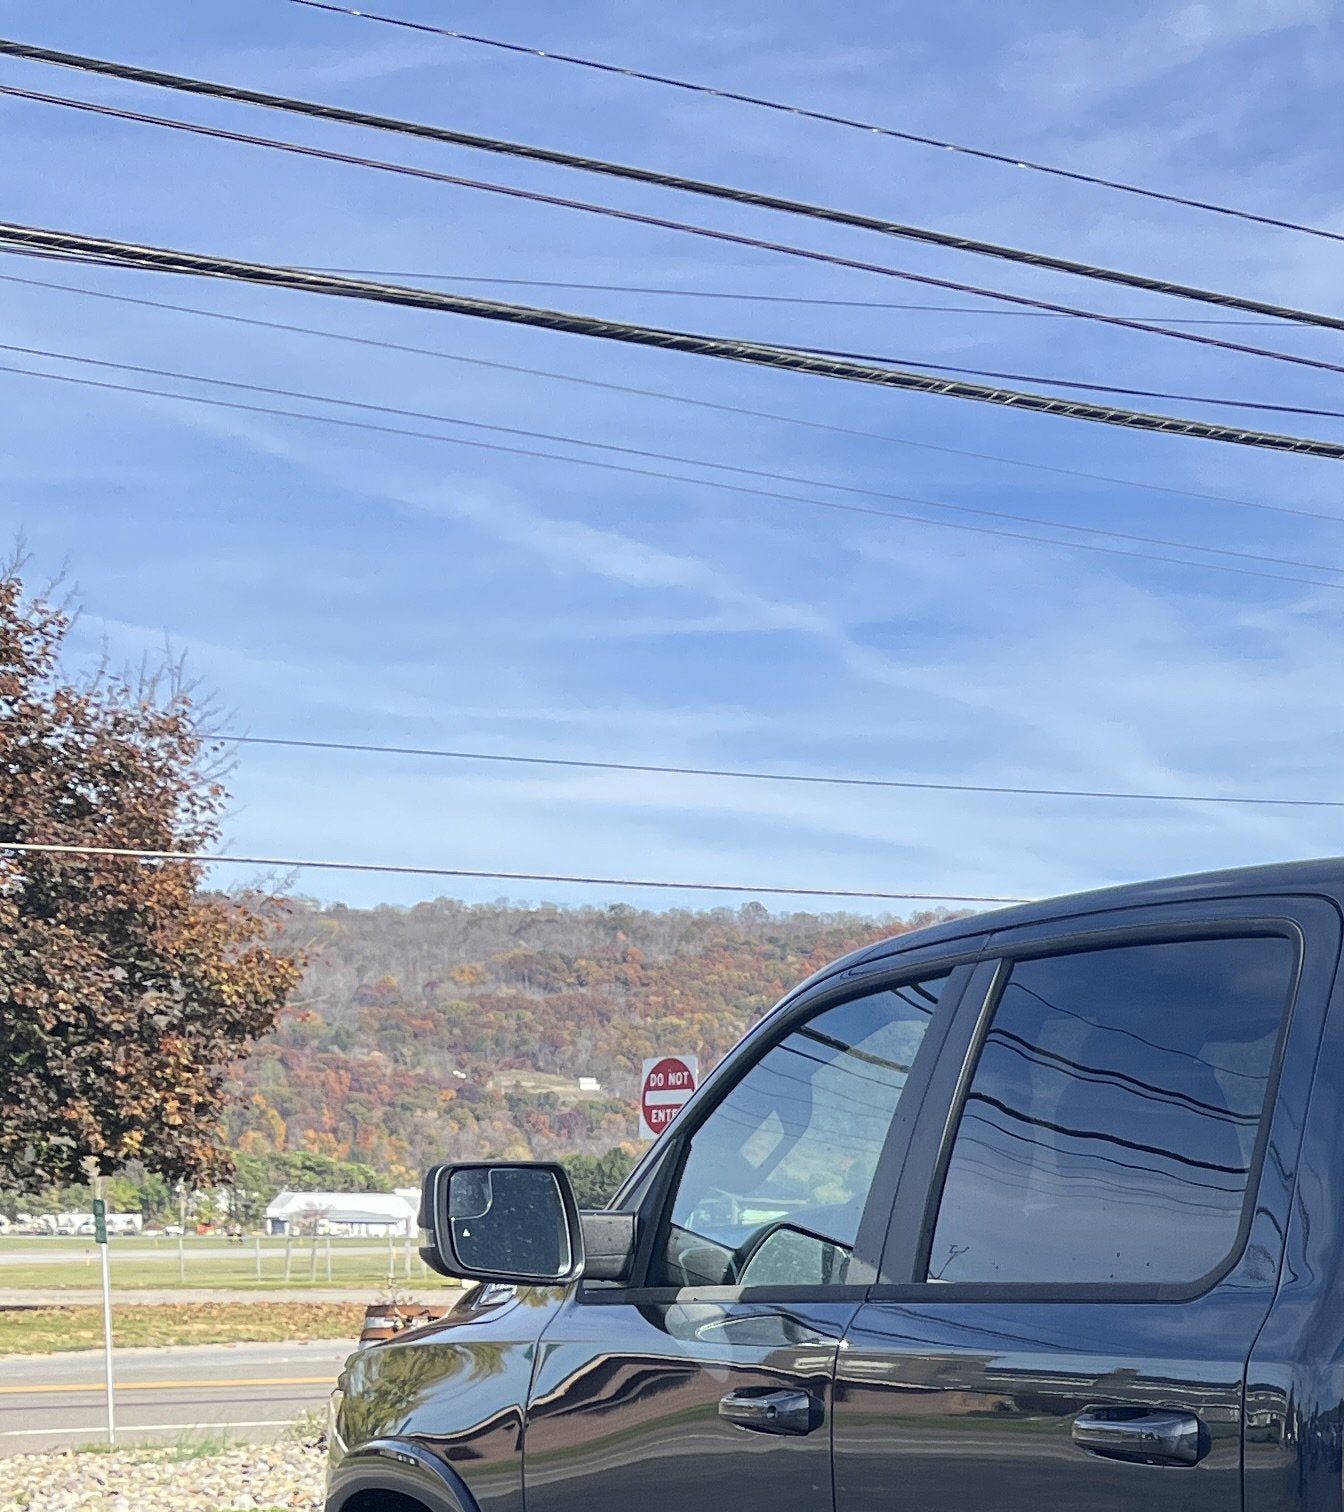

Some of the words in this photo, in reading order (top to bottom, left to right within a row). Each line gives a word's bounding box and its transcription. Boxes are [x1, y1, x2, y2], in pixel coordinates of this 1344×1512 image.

[650, 1073, 664, 1087] DO
[668, 1071, 689, 1085] NOT
[651, 1108, 679, 1123] ENTE
